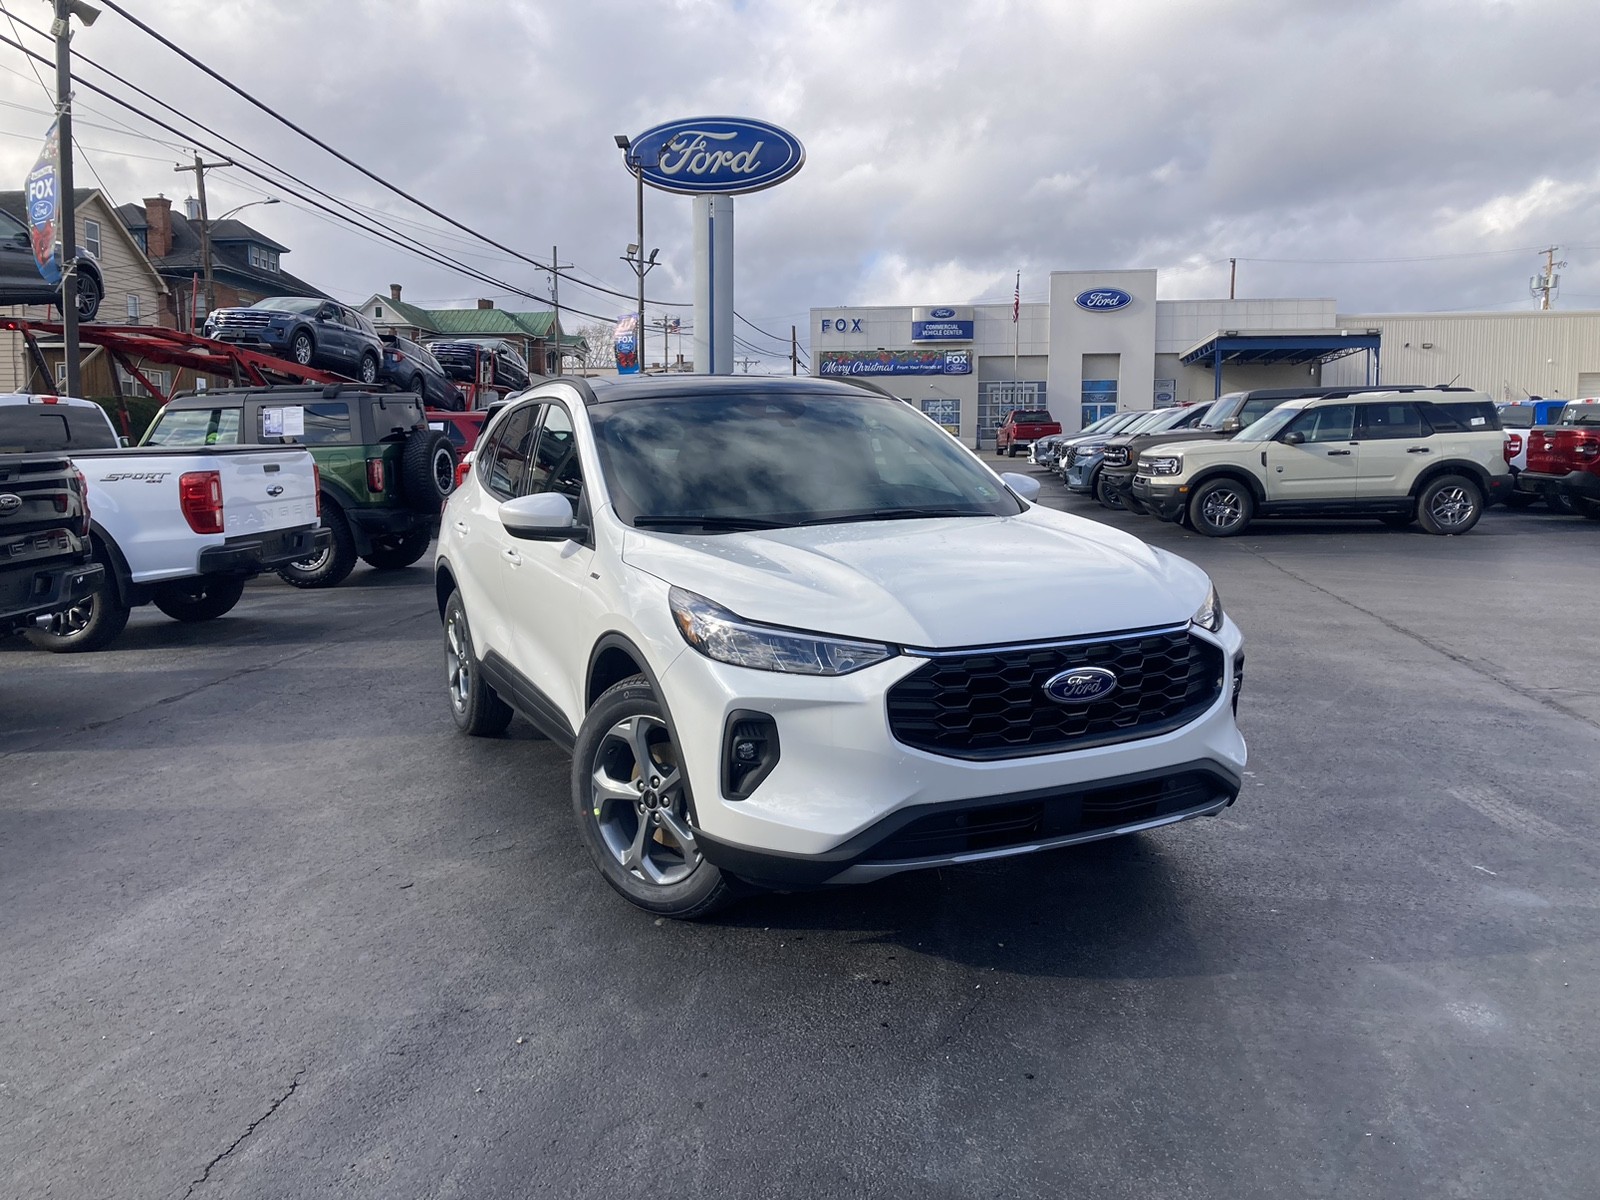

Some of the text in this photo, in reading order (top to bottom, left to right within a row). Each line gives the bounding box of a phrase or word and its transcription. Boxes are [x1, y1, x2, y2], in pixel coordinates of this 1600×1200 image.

[659, 130, 764, 175] Ford
[29, 177, 54, 202] FOX
[1086, 292, 1120, 306] Ford
[935, 309, 951, 317] Ford
[821, 318, 864, 333] FOX
[617, 335, 634, 344] FOX
[946, 355, 967, 364] FOX
[821, 360, 851, 376] Merry
[852, 360, 895, 374] Christmas
[928, 406, 953, 416] FOX
[100, 472, 172, 482] SPORT
[227, 502, 314, 527] RANGER
[1063, 675, 1102, 697] Ford
